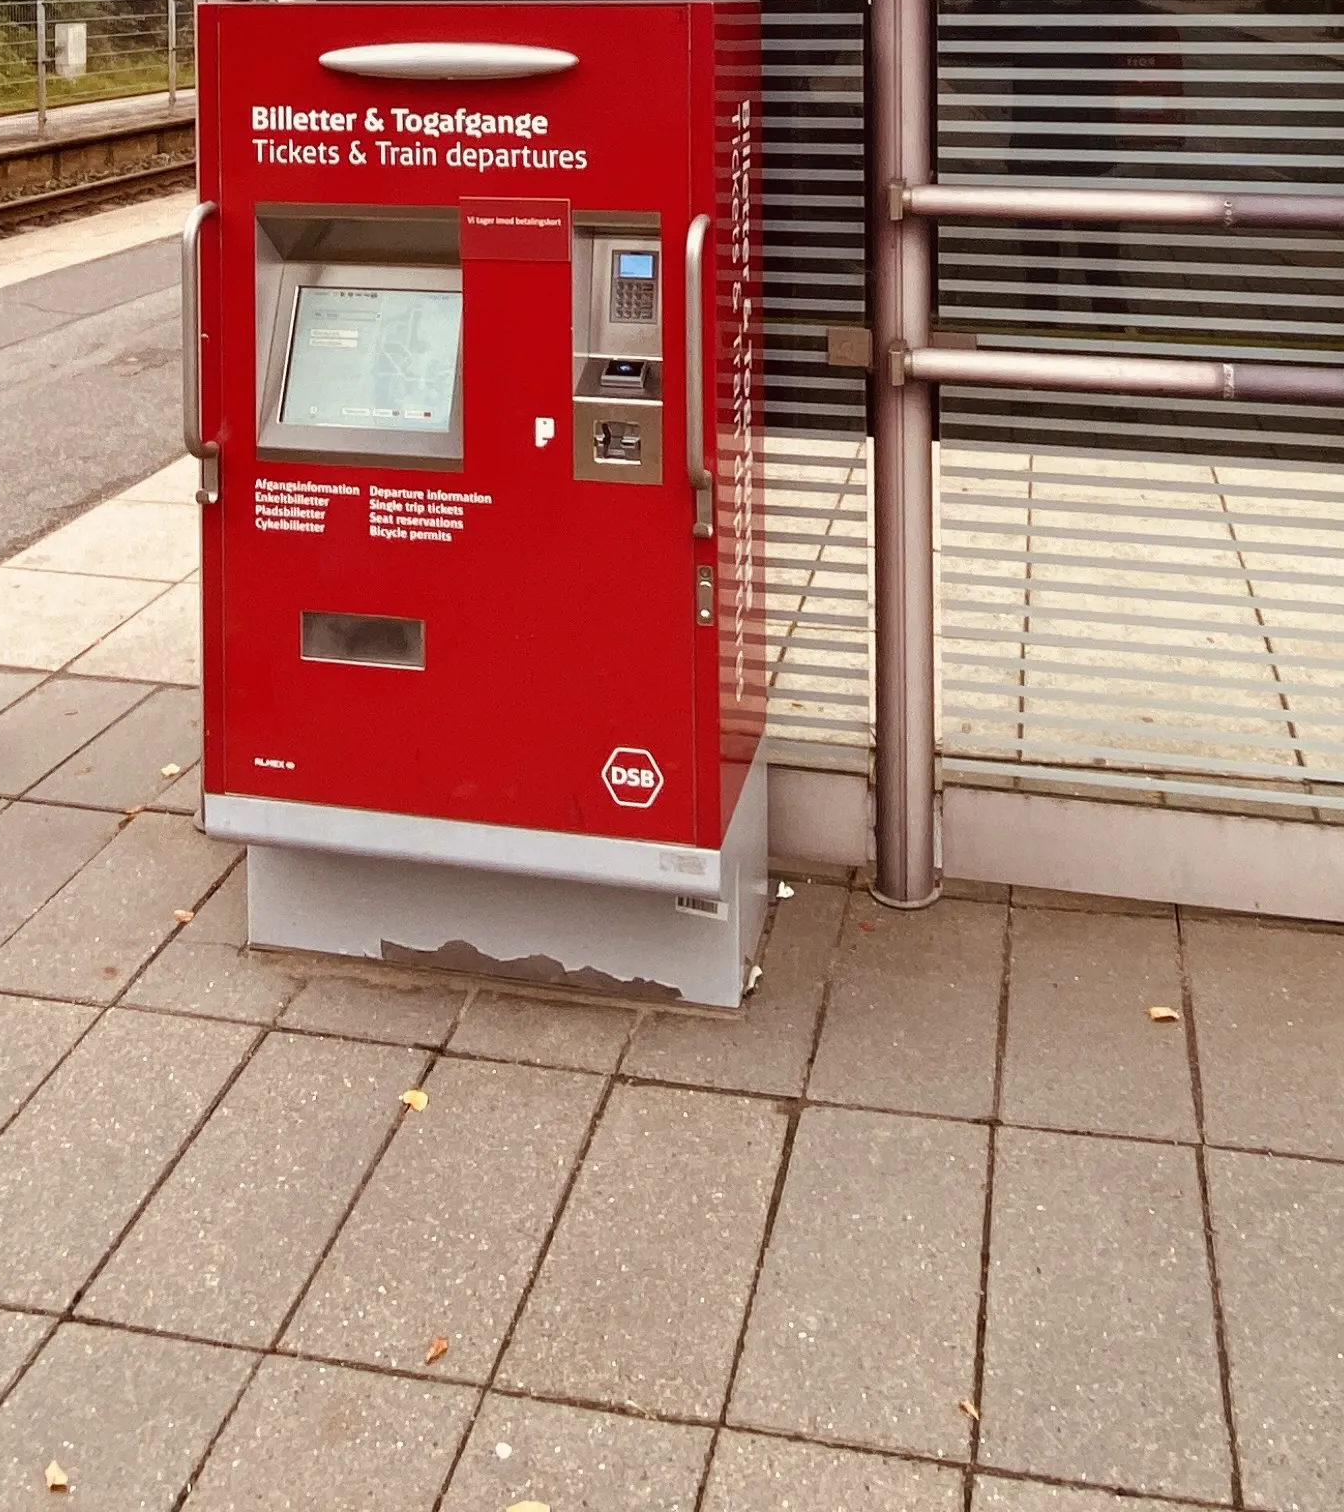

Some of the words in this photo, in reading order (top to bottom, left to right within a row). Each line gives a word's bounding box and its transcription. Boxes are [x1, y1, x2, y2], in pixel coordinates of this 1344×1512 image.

[252, 106, 357, 132] Billetter
[364, 108, 385, 132] &
[391, 108, 549, 138] Togafgange
[252, 139, 340, 164] Tickets
[348, 141, 367, 165] &
[375, 141, 437, 167] Train
[446, 142, 588, 173] departures
[732, 103, 741, 264] Tickets
[733, 323, 743, 440] Train
[255, 479, 360, 496] Afgangsinformation
[369, 486, 424, 500] Departure
[427, 489, 493, 504] information
[255, 491, 330, 507] Enkeltbilletter
[369, 499, 402, 513] Single
[405, 502, 424, 514] trip
[427, 503, 464, 516] tickets
[255, 504, 325, 520] Pladsbilletter
[369, 512, 393, 525] Seat
[396, 516, 464, 529] reservations
[255, 518, 325, 533] Cykelbilletter
[369, 525, 407, 539] Bicycle
[410, 529, 452, 542] permits
[611, 766, 655, 788] DSB
